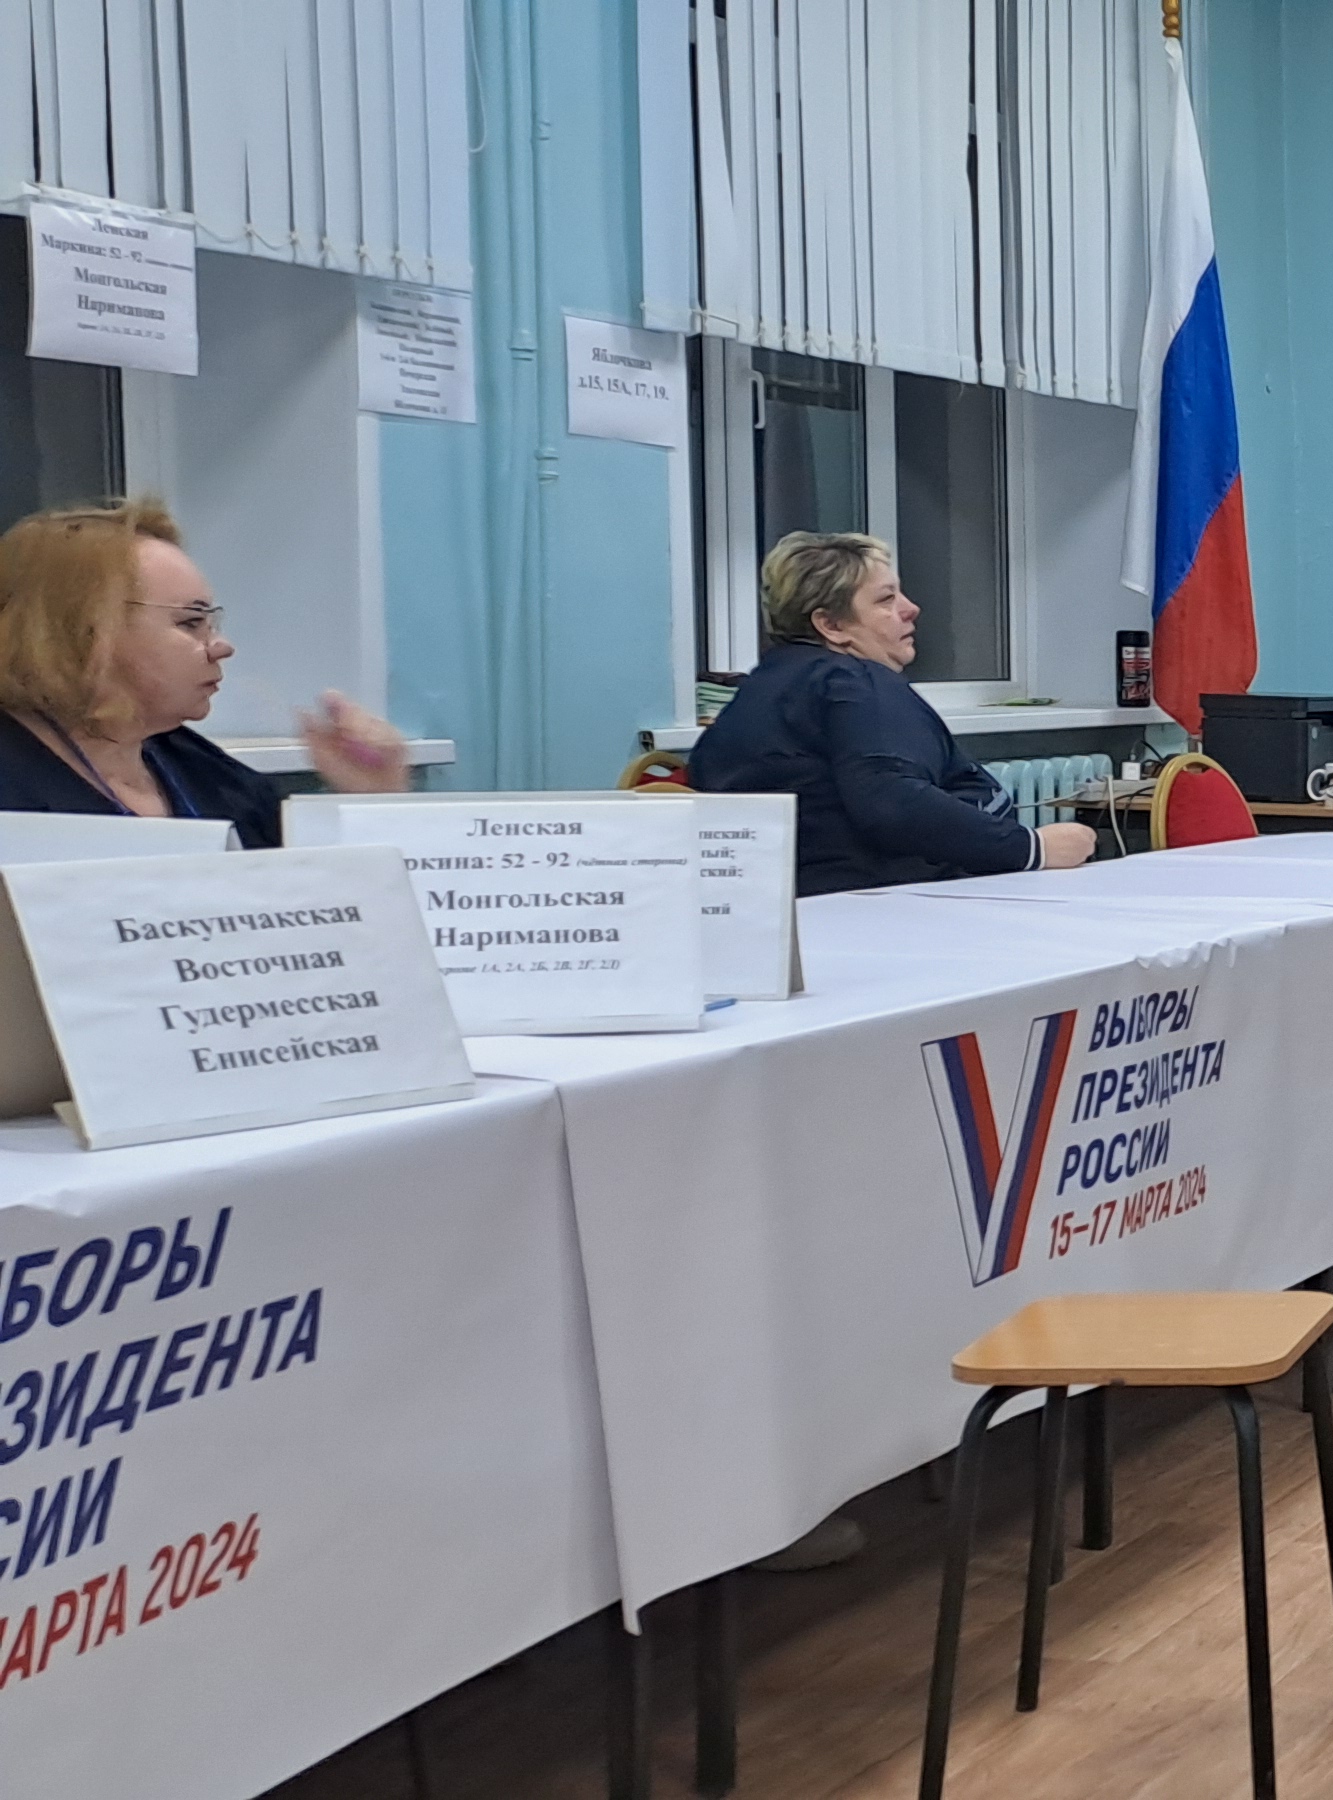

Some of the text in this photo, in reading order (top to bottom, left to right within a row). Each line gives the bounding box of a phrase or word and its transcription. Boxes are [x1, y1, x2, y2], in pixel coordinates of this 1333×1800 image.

[466, 818, 583, 838] Ленская
[402, 856, 493, 871] ркина:
[501, 853, 525, 869] 52
[546, 852, 570, 867] 92
[426, 889, 625, 911] Монгольская
[114, 905, 362, 943] Баскунчакская
[434, 927, 620, 951] Нариманова
[172, 950, 345, 983] Восточная
[160, 990, 380, 1034] Гудермесская
[1088, 985, 1200, 1052] ВЫБОРЫ
[191, 1034, 380, 1073] Енисейская
[1071, 1039, 1226, 1123] ПРЕЗИДЕНТА
[1056, 1118, 1171, 1196] РОССИИ
[1118, 1178, 1173, 1239] МАРТА
[1174, 1164, 1206, 1215] 2024
[0, 1206, 233, 1345] БОРЫ
[0, 1286, 324, 1466] ЗИДЕНТА
[139, 1511, 262, 1627] 2024
